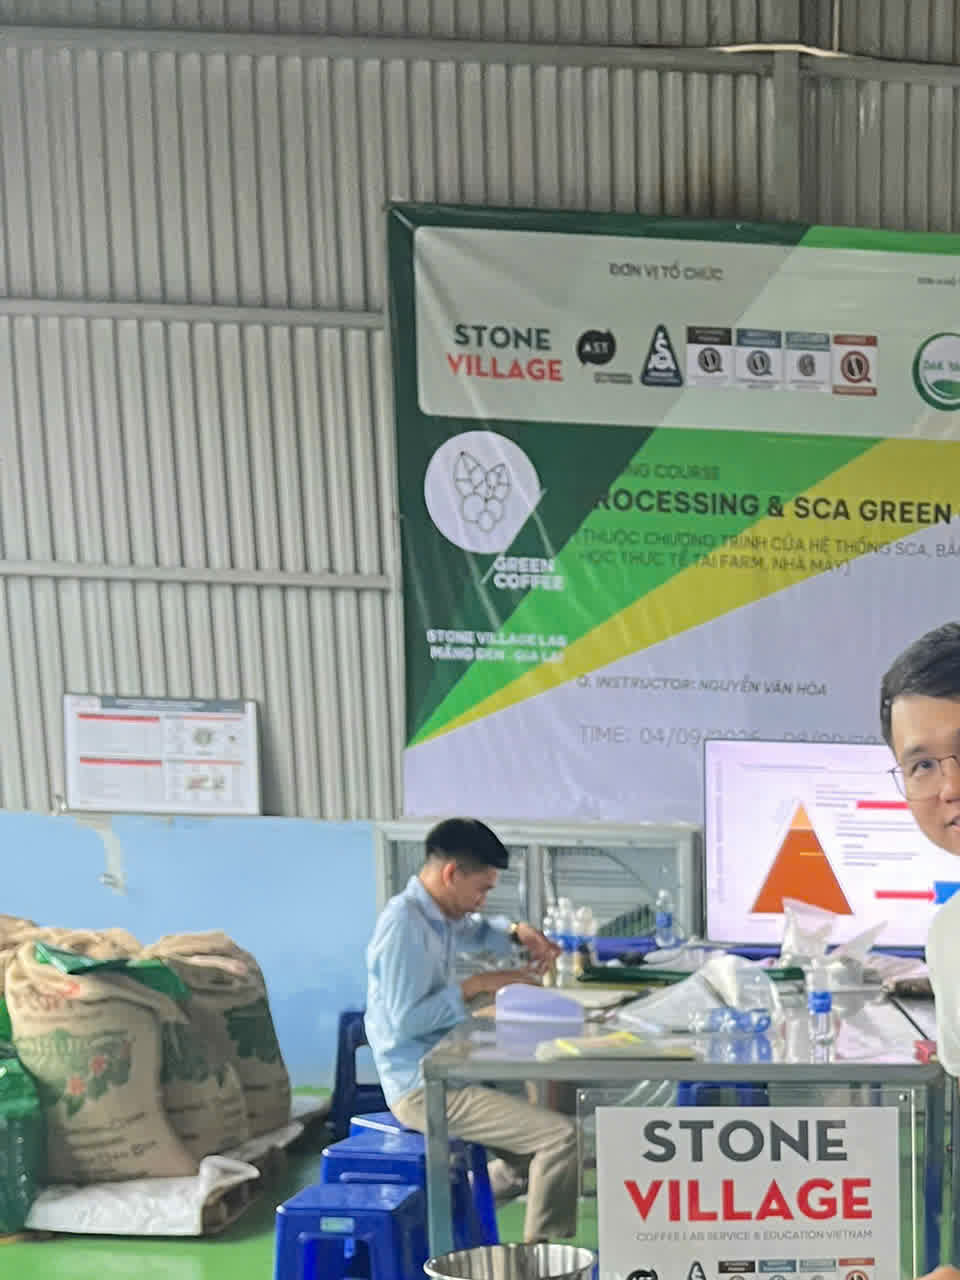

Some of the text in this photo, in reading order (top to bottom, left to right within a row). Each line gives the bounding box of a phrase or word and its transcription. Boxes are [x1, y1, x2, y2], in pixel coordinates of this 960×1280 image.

[454, 324, 551, 351] STONE
[447, 354, 563, 382] VILLAGE
[592, 488, 760, 518] ROCESSING
[767, 496, 784, 518] &
[794, 498, 850, 520] SCA
[859, 500, 952, 525] GREEN
[642, 1119, 847, 1162] STONE
[624, 1178, 872, 1222] VILLAGE
